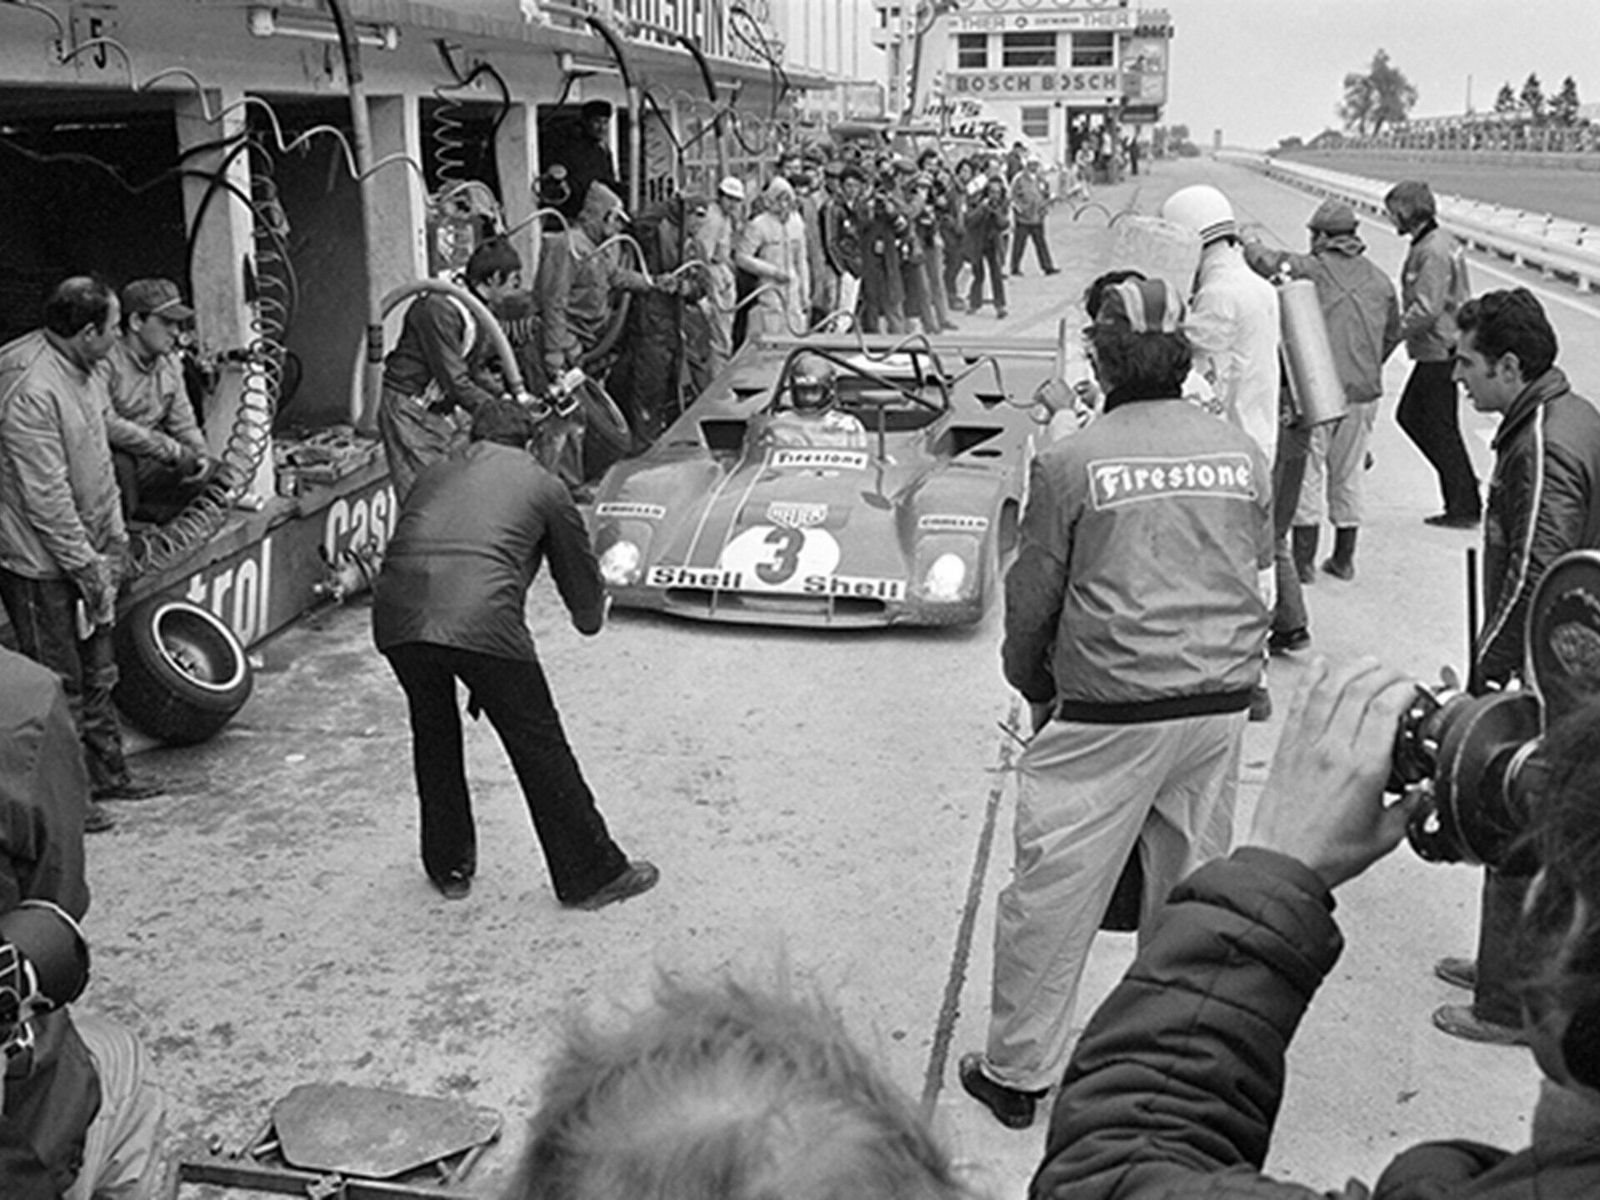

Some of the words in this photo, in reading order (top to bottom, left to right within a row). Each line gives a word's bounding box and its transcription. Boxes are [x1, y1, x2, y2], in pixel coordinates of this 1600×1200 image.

[956, 75, 1031, 92] BOSCH
[1042, 74, 1117, 91] BOSCH
[779, 451, 862, 465] Firestone
[1096, 461, 1251, 500] Firestone
[755, 526, 806, 585] 3
[652, 567, 743, 590] Shell
[803, 575, 899, 598] Shell
